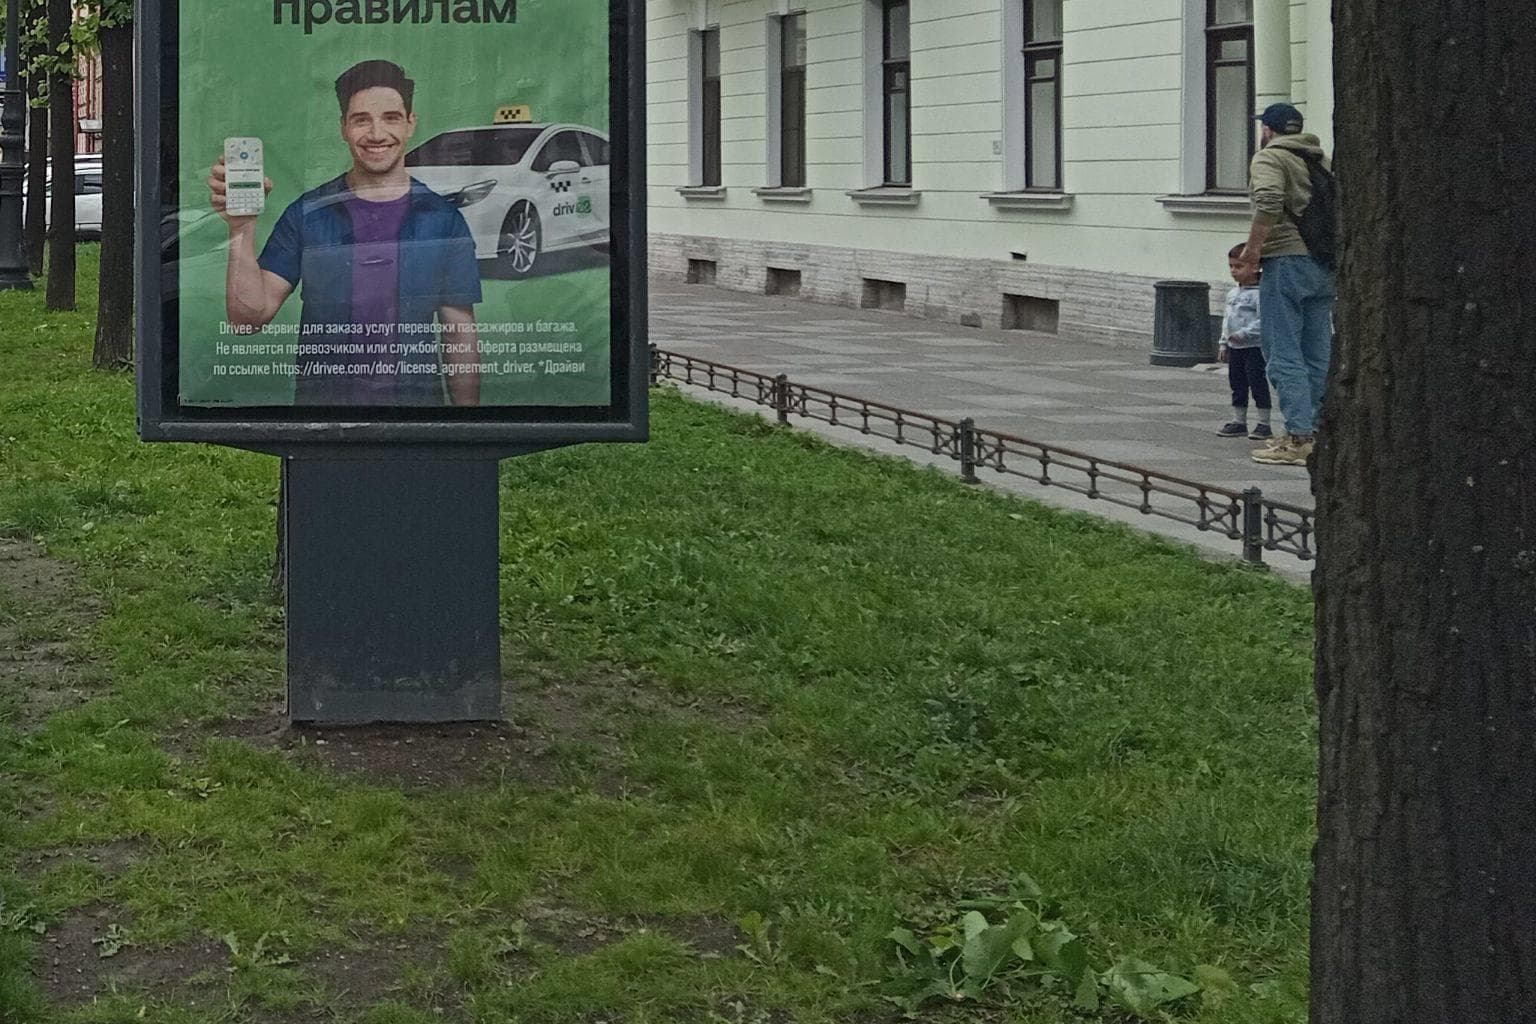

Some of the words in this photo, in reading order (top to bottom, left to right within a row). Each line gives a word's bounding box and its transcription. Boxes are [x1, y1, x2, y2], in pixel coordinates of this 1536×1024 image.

[219, 321, 253, 335] Drivee
[261, 322, 300, 336] сервис
[302, 322, 324, 336] для
[325, 322, 363, 334] заказа
[365, 322, 395, 336] услуг
[397, 322, 455, 336] перевозки
[457, 321, 524, 336] пассажиров
[526, 322, 534, 333] и
[535, 319, 578, 333] багажа.
[216, 341, 230, 354] Не
[232, 343, 284, 355] является
[286, 342, 364, 356] перевозчиком
[366, 343, 388, 354] или
[389, 340, 438, 356] службой
[440, 342, 474, 354] такси.
[476, 339, 517, 355] Оферта
[519, 341, 583, 355] размещена
[213, 364, 227, 375] по
[229, 364, 270, 375] ссылке
